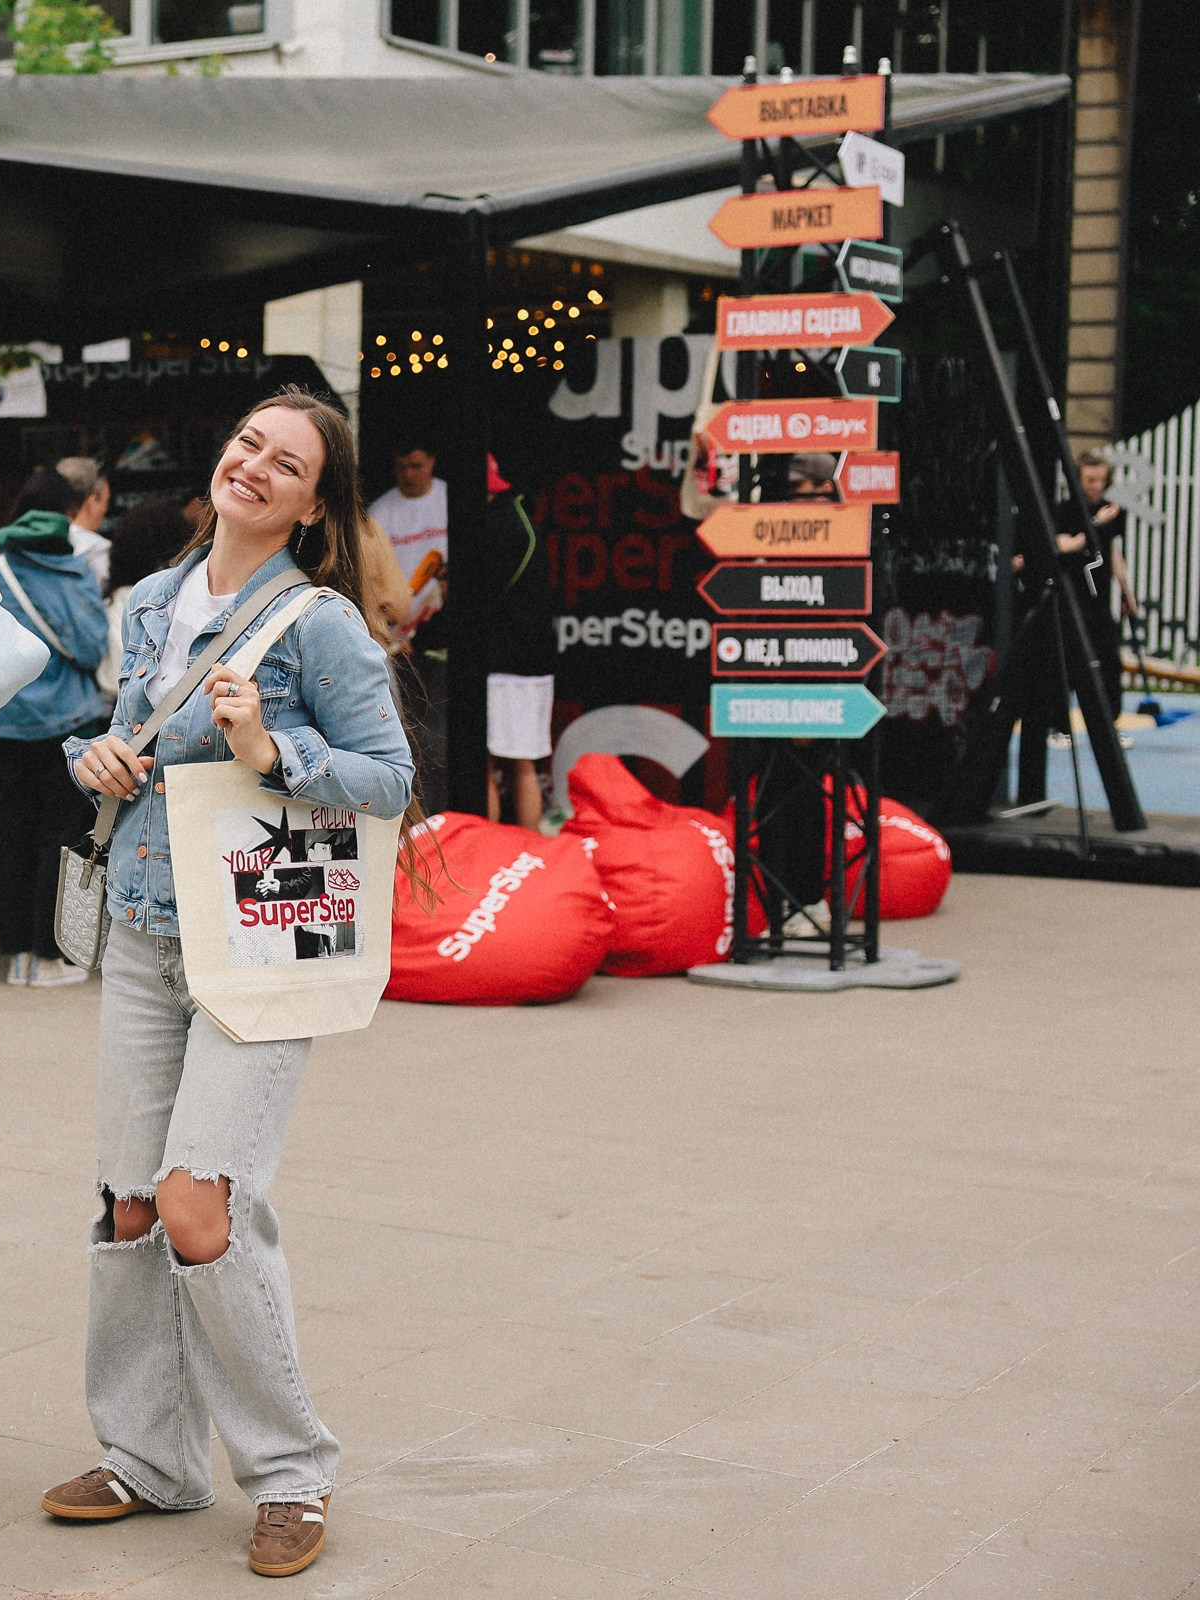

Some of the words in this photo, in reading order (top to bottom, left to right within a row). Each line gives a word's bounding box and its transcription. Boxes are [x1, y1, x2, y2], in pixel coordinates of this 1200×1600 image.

[760, 95, 847, 122] ВЫСТАВКА
[773, 205, 832, 230] МАРКЕТ
[726, 308, 803, 337] ГЛАВНАЯ
[804, 306, 862, 339] СЦЕНА
[727, 413, 783, 445] СЦЕНА
[813, 415, 867, 438] Звук
[755, 519, 830, 544] ФУДКОРТ
[760, 575, 825, 606] ВЫХОД
[744, 637, 784, 667] МЕД.
[784, 637, 859, 667] ПОМОЩЬ
[728, 698, 845, 724] STEREOLOUNGE
[222, 847, 281, 876] YOUR
[238, 892, 355, 932] SuperStep
